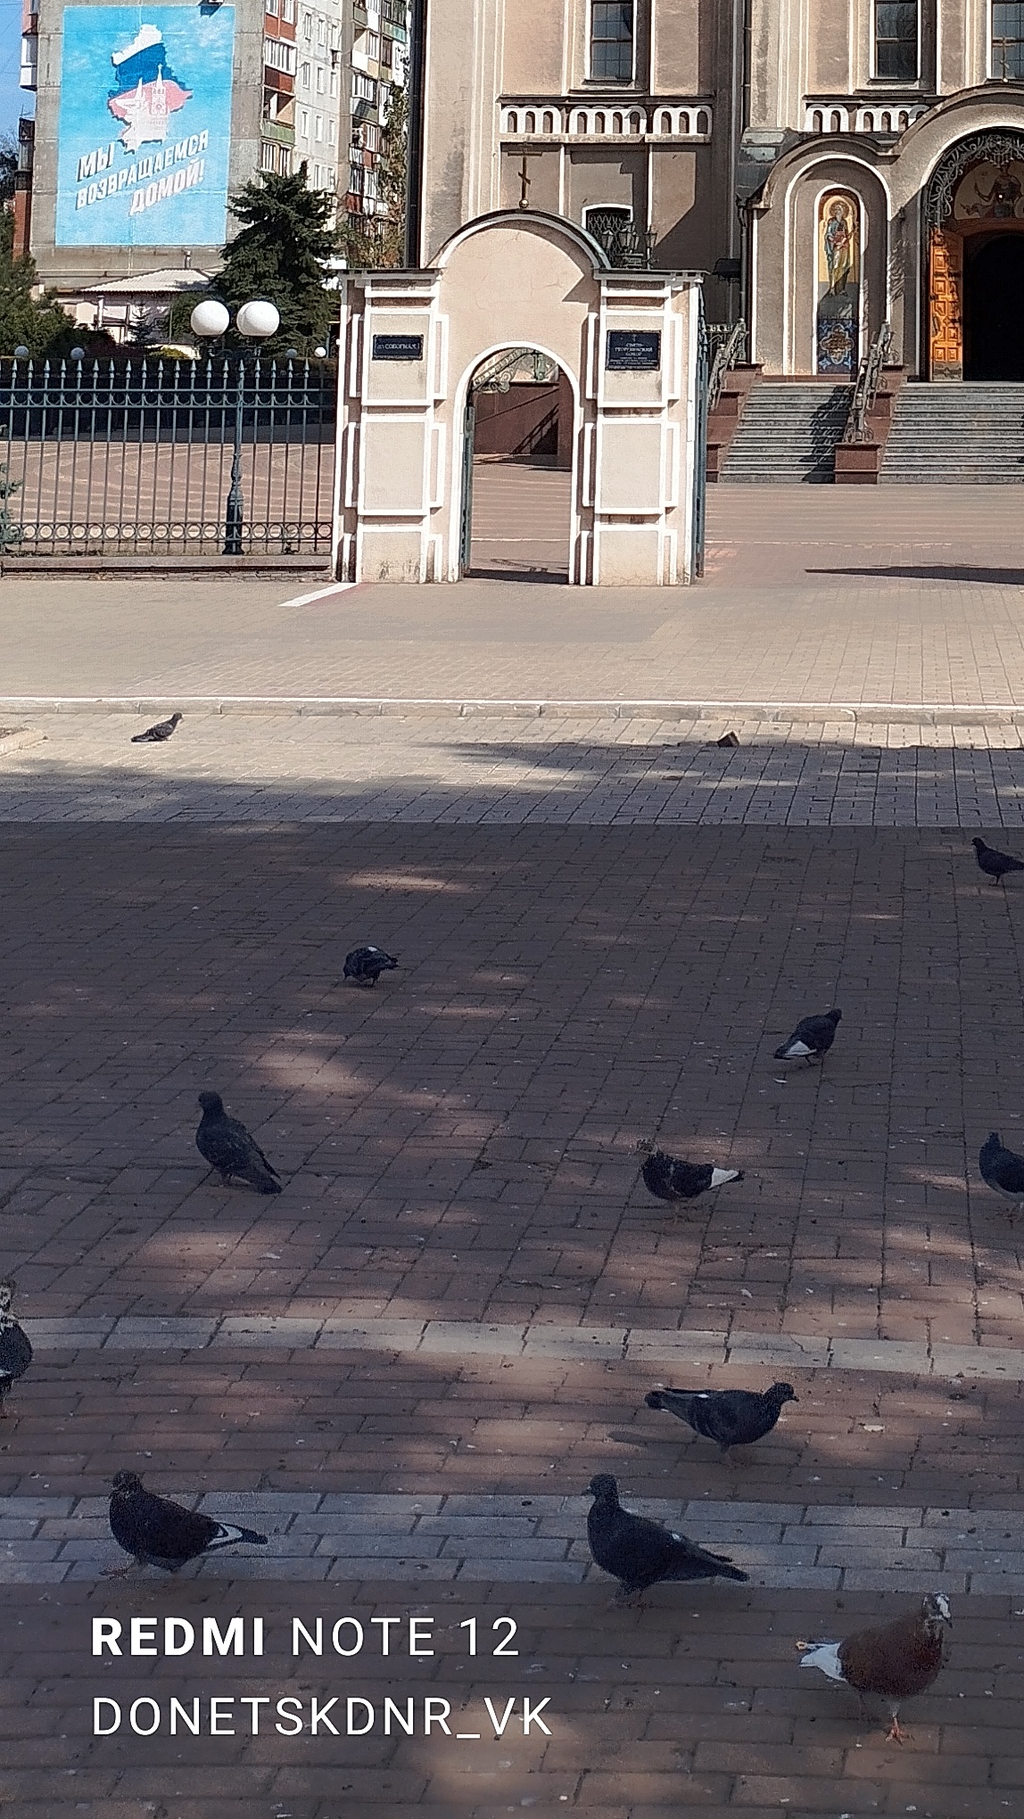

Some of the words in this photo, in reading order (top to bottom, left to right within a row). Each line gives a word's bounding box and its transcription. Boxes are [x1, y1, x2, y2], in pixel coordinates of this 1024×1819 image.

[75, 129, 209, 210] ВОЗВРАЩАЕМСЯ
[76, 142, 115, 182] МЫ
[128, 157, 205, 217] ДОМОЙ!
